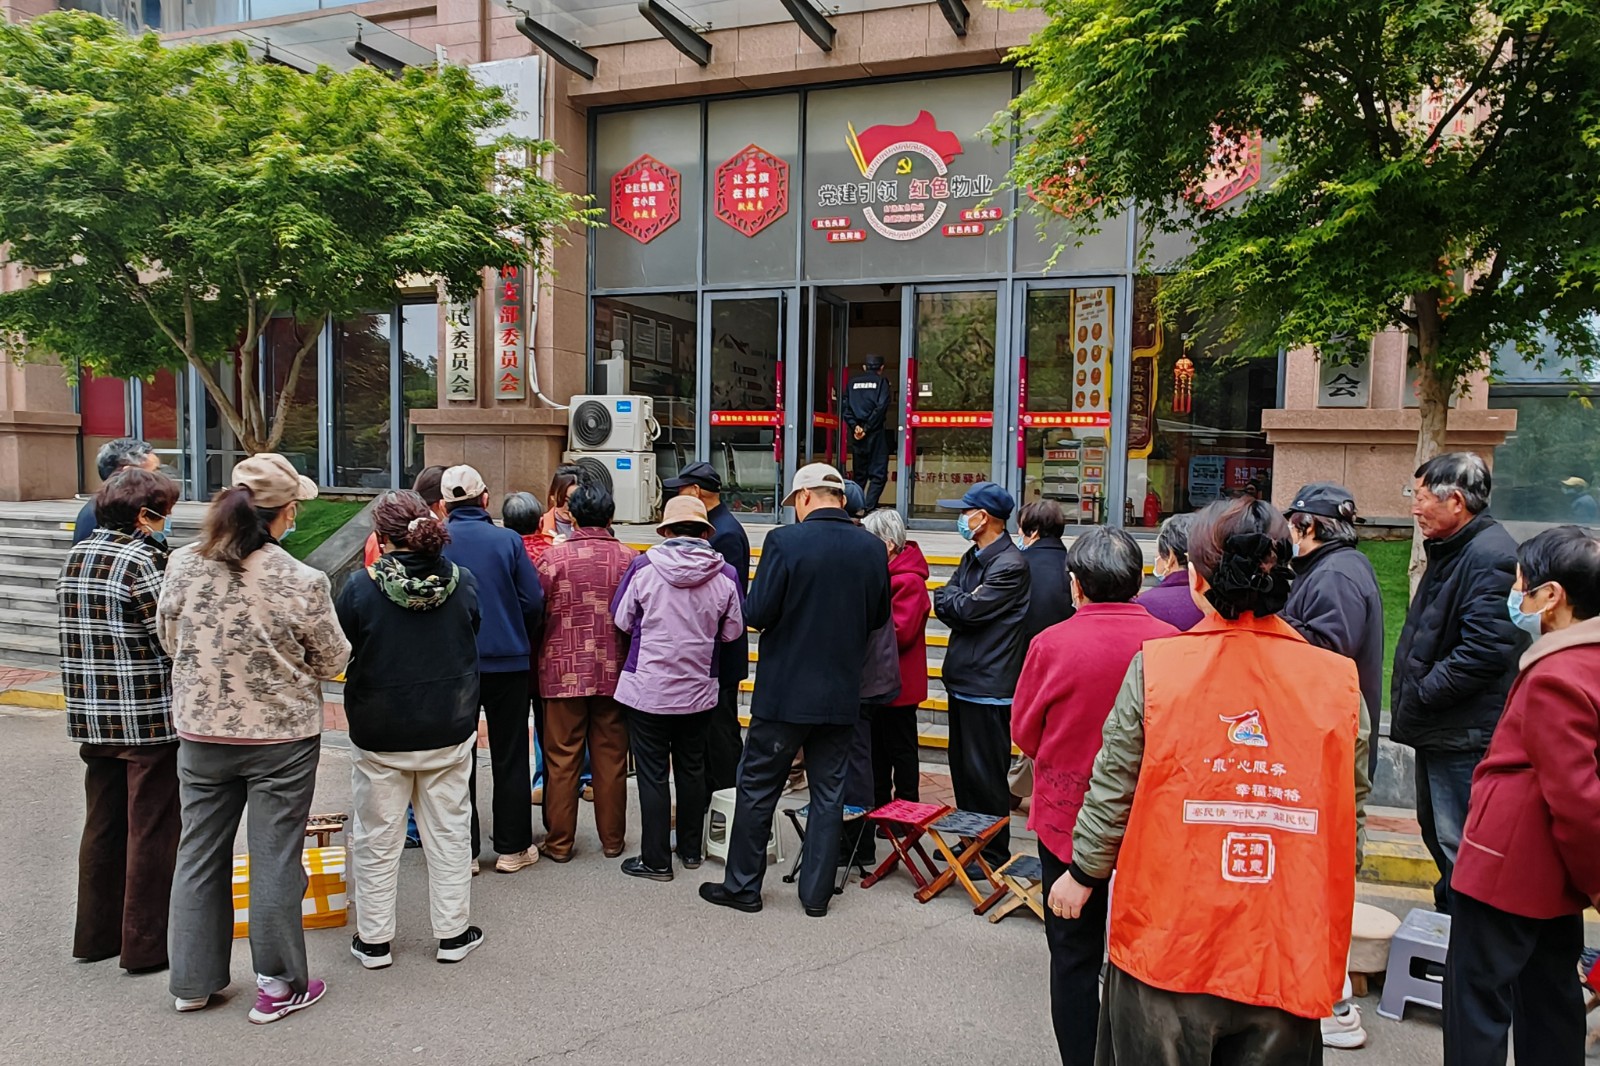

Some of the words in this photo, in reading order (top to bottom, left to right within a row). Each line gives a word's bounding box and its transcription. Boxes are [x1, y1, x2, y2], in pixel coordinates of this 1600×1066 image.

[632, 196, 657, 207] 在小区
[817, 179, 898, 207] 党建引领
[908, 174, 993, 200] 红色物业
